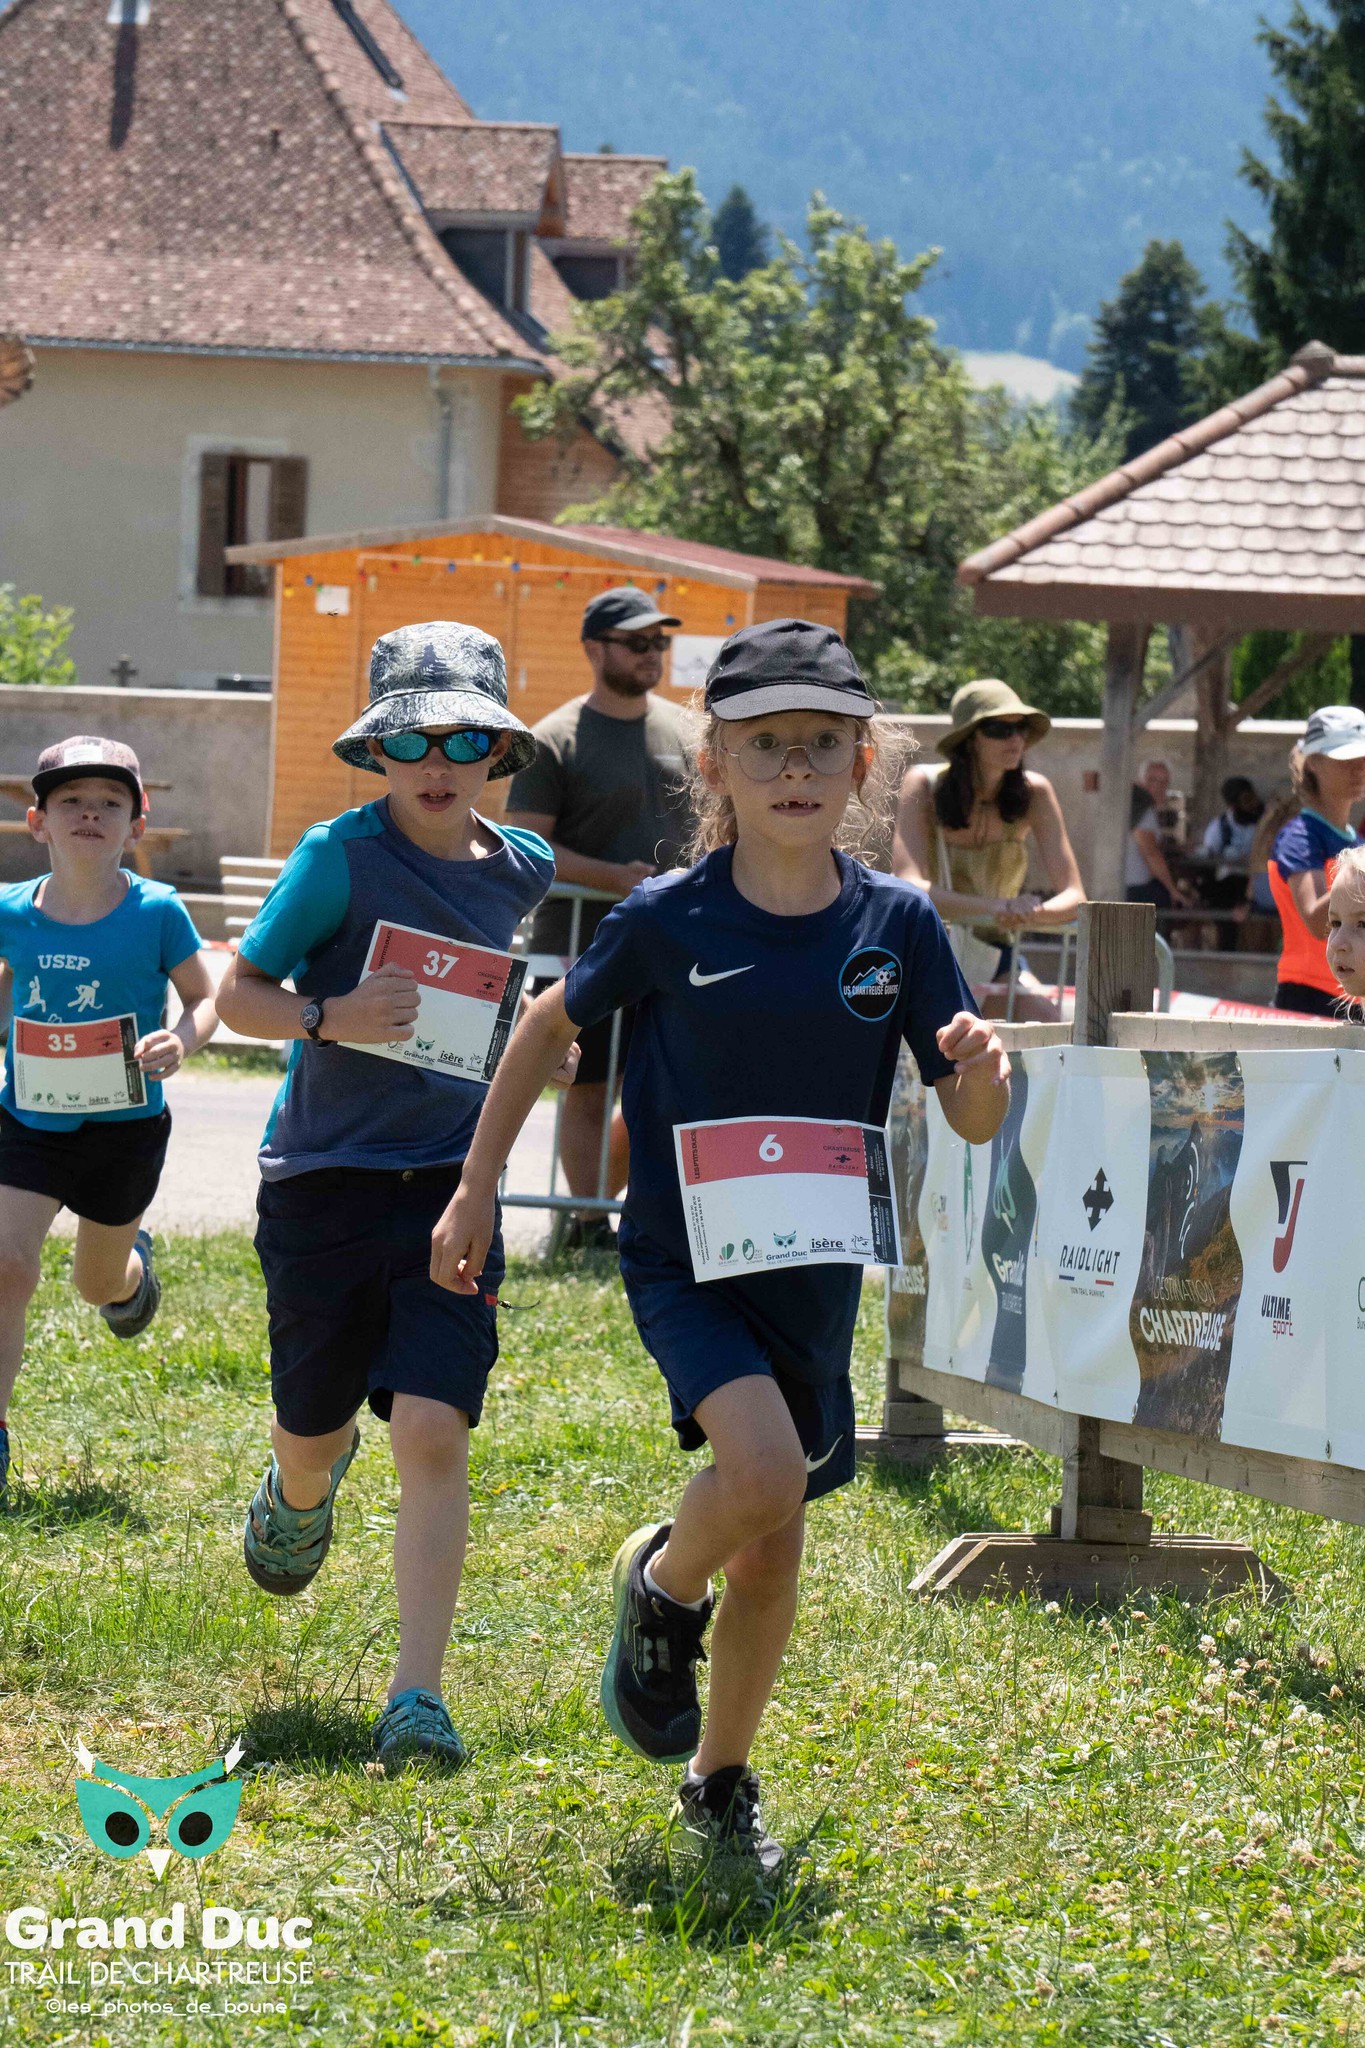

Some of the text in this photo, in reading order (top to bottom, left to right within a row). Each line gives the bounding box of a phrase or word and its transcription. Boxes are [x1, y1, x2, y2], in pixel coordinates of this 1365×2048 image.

[38, 954, 91, 971] USEP
[422, 950, 460, 979] 37
[843, 985, 851, 995] US
[852, 984, 884, 995] CHARTREUSE
[48, 1034, 77, 1052] 35
[404, 1050, 423, 1060] Grand
[440, 1050, 464, 1064] isère
[758, 1133, 784, 1162] 6
[811, 1237, 843, 1249] isère
[766, 1251, 790, 1261] Grand
[1059, 1245, 1120, 1274] RAIDLIGHT
[1154, 1276, 1216, 1304] DESTINATION
[1261, 1294, 1291, 1320] ULTIME
[1139, 1307, 1227, 1351] CHARTREUSE
[1272, 1311, 1294, 1341] sport
